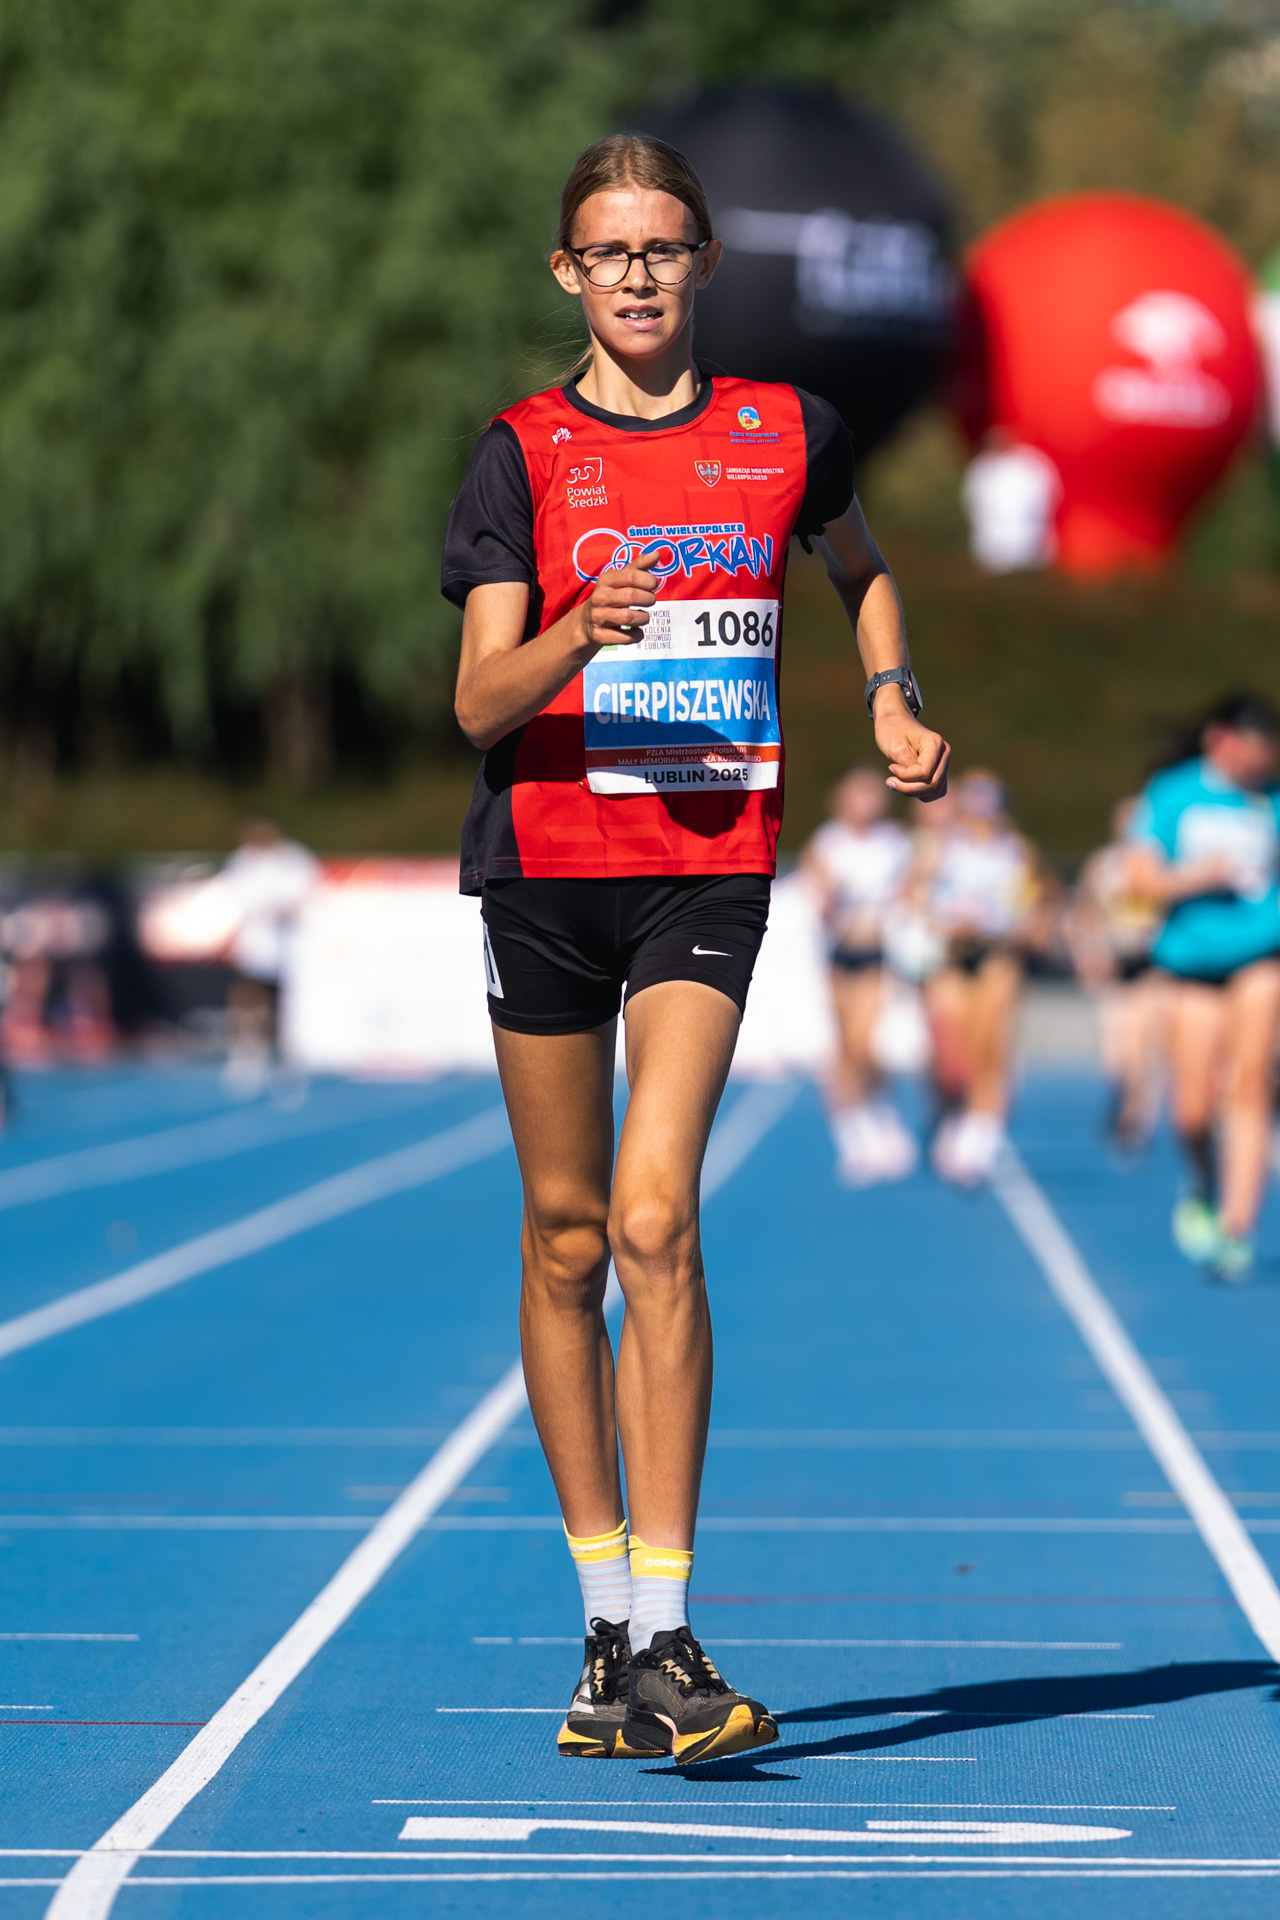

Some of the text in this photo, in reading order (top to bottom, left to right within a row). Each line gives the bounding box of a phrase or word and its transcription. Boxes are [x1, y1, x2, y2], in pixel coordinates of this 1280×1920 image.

[566, 484, 607, 497] Powiat
[568, 495, 608, 509] Średzki
[641, 534, 773, 579] ORKAN
[694, 610, 773, 647] 1086
[593, 679, 771, 725] CIERPISZEWSKA
[645, 749, 664, 757] PZLA
[665, 747, 712, 756] Mistrzostwa
[713, 746, 736, 755] Polski
[617, 758, 638, 766] MAŁY
[640, 757, 680, 765] MEMORIAŁ
[681, 755, 716, 764] JANUSZA
[644, 768, 749, 785] LUBLIN 2025
